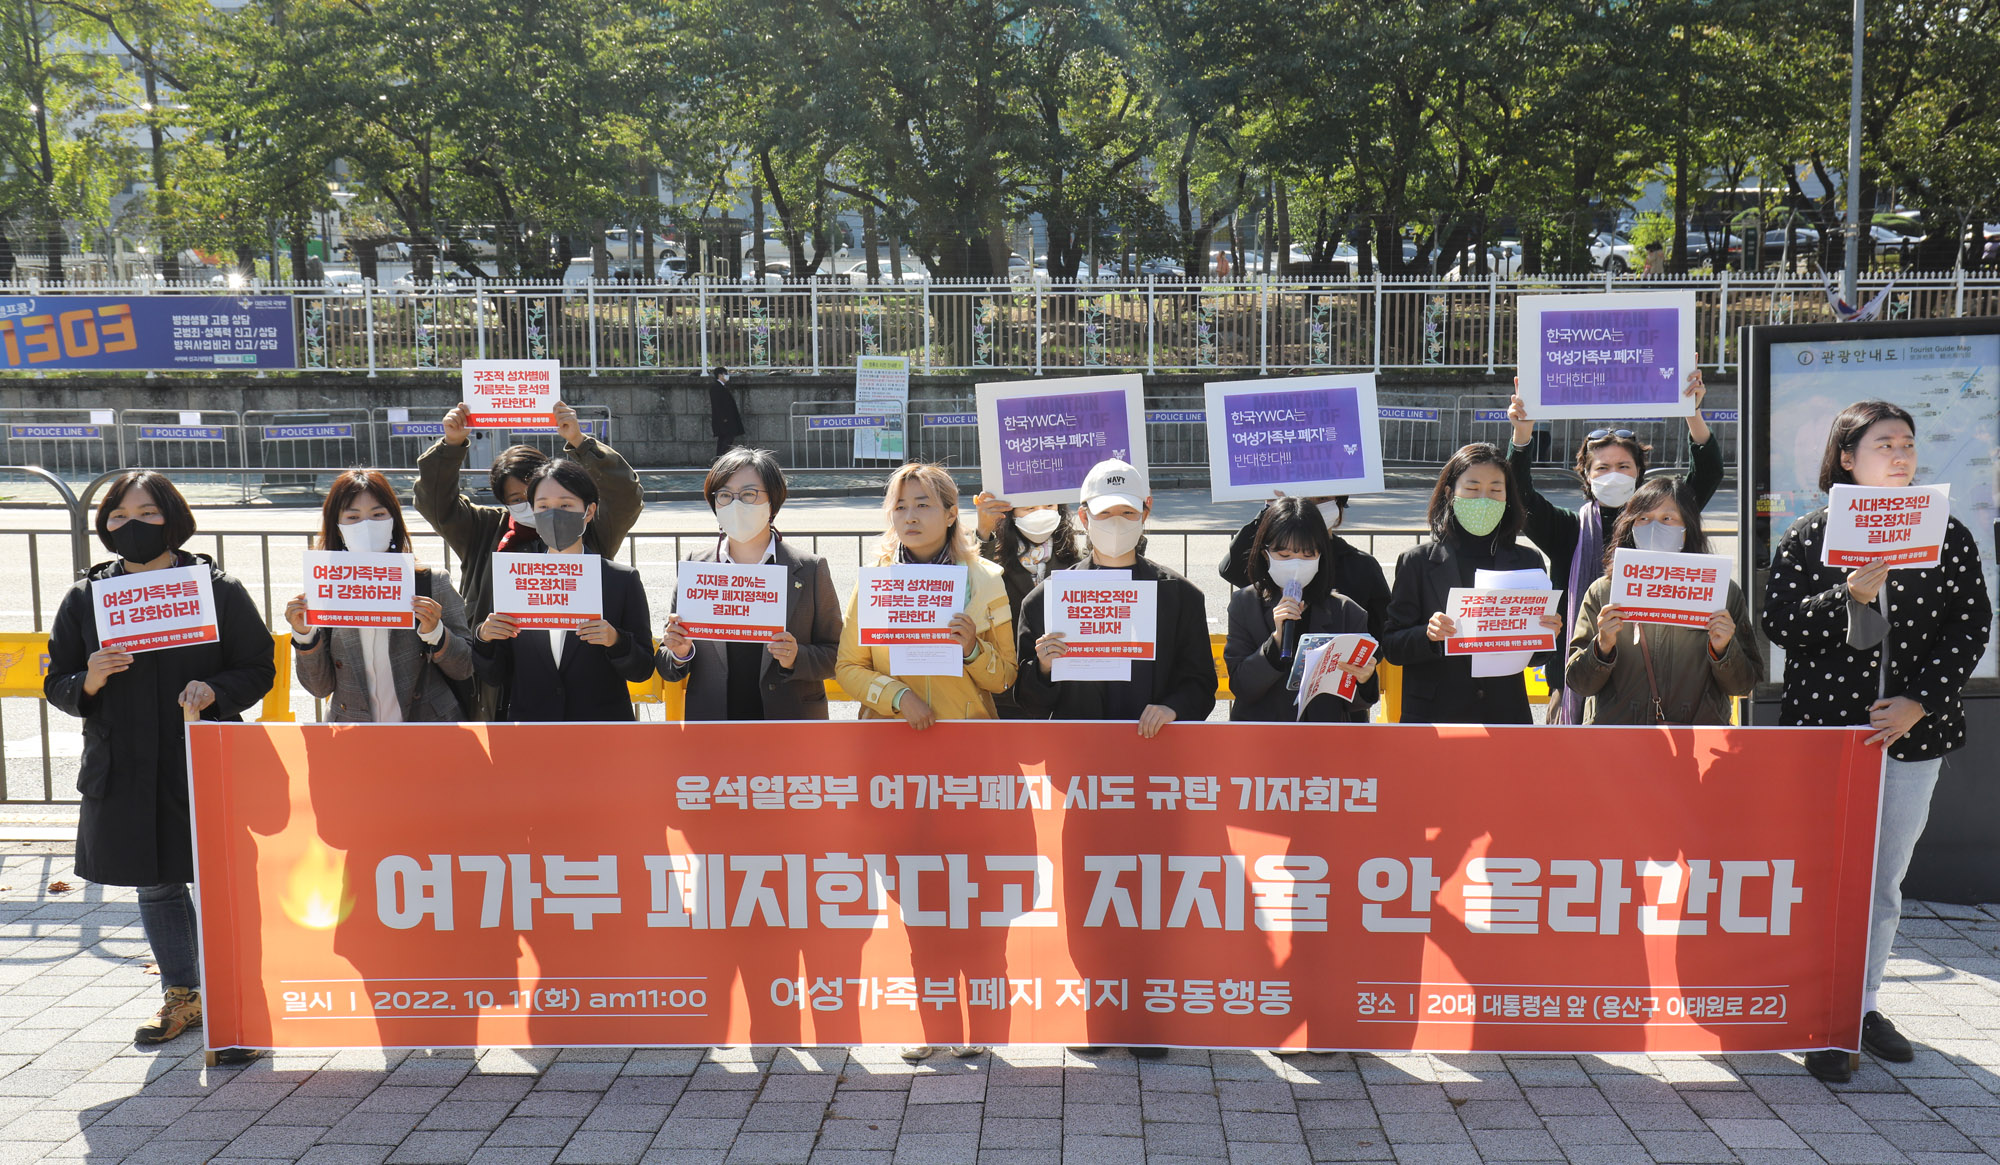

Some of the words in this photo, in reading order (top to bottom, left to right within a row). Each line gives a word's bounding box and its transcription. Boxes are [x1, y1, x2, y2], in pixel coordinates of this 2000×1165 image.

[172, 315, 208, 326] 병영생활
[231, 315, 250, 326] 상담
[234, 327, 277, 338] 신고/상담
[1546, 327, 1625, 343] 한국YWCA는
[174, 339, 231, 351] 방위사업비리
[235, 339, 278, 351] 신고/상담
[1956, 344, 1972, 352] Map
[1546, 350, 1612, 366] '여성가족부
[1613, 348, 1655, 364] 폐지'를
[1821, 349, 1898, 365] 관광안내도
[473, 371, 505, 381] 구조적
[507, 371, 550, 381] 성차별에
[1546, 372, 1606, 388] 반대한다!!!
[473, 384, 517, 395] 기름붓는
[518, 384, 550, 395] 윤석열
[491, 397, 536, 409] 규탄한다!
[937, 416, 965, 424] POLICE
[967, 415, 978, 423] LIN
[1155, 413, 1183, 421] POLICE
[1230, 408, 1307, 426] 한국YWCA는
[1377, 409, 1405, 418] POLICE
[1407, 410, 1424, 418] LINE
[1714, 412, 1738, 420] POLIC
[823, 418, 852, 426] POLICE
[854, 417, 871, 425] LINE
[1003, 412, 1078, 432] 한국YWCA는
[27, 427, 60, 436] POLICE
[63, 427, 83, 436] LINE
[156, 429, 187, 437] POLICE
[189, 429, 207, 437] LINE
[280, 428, 314, 437] POLICE
[316, 427, 335, 436] LINE
[406, 425, 438, 434] POLICE
[1232, 429, 1297, 447] '여성가족부
[1298, 426, 1338, 443] 폐지'를
[1005, 436, 1068, 453] '여성가족부
[1069, 431, 1107, 448] 폐지'를
[1234, 451, 1292, 468] 반대한다!!!
[1007, 458, 1064, 476] 반대한다!!!
[1106, 476, 1126, 485] NAVY
[1848, 495, 1930, 512] 시대착오적인
[1855, 511, 1922, 528] 혐오정치를
[1867, 528, 1912, 544] 끝내자!
[313, 565, 403, 582] 여성가족부를
[508, 562, 583, 577] 시대착오적인
[1623, 563, 1717, 584] 여성가족부를
[515, 577, 577, 591] 혐오정치를
[695, 574, 729, 587] 지지율
[731, 576, 766, 588] 20%는
[871, 579, 905, 592] 구조적
[907, 579, 954, 592] 성차별에
[103, 580, 199, 608] 여성가족부를
[318, 584, 333, 599] 더
[337, 584, 402, 601] 강화하라!
[686, 588, 719, 601] 여가부
[721, 589, 778, 603] 폐지정책의
[1061, 590, 1139, 604] 시대착오적인
[1626, 582, 1642, 598] 더
[1646, 583, 1714, 602] 강화하라!
[527, 593, 569, 606] 끝내자!
[870, 594, 914, 608] 기름붓는
[917, 594, 953, 607] 윤석열
[1461, 595, 1498, 605] 구조적
[1500, 596, 1549, 605] 성차별에
[109, 610, 125, 627] 더
[128, 600, 200, 624] 강화하라!
[713, 603, 750, 617] 결과다!
[887, 610, 936, 623] 규탄한다!
[1067, 605, 1131, 619] 혐오정치를
[1459, 606, 1507, 618] 기름붓는
[1508, 606, 1546, 616] 윤석열
[1079, 621, 1122, 635] 끝내자!
[1477, 618, 1528, 632] 규탄한다!
[675, 775, 859, 811] 윤석열정부
[869, 774, 1052, 811] 여가부폐지
[1062, 775, 1135, 811] 시도
[1146, 775, 1221, 811] 규탄
[1230, 776, 1378, 813] 기자회견
[375, 853, 623, 932] 여가부
[643, 852, 1059, 931] 폐지한다고
[1082, 853, 1331, 933] 지지율
[1356, 855, 1441, 935] 안
[1462, 855, 1804, 938] 올라간다
[282, 991, 332, 1012] 일시
[373, 991, 456, 1011] 2022.
[464, 989, 502, 1010] 10.
[588, 988, 707, 1009] am11:00
[770, 976, 957, 1011] 여성가족부
[968, 976, 1042, 1011] 폐지
[1054, 977, 1129, 1011] 저지
[1143, 977, 1293, 1015] 공동행동
[1356, 992, 1396, 1016] 장소
[1427, 992, 1476, 1017] 20대
[1482, 994, 1561, 1018] 대통령실
[1566, 995, 1587, 1018] 앞
[1592, 995, 1661, 1019] (용산구
[1666, 995, 1744, 1018] 이태원로
[1749, 994, 1787, 1018] 22)
